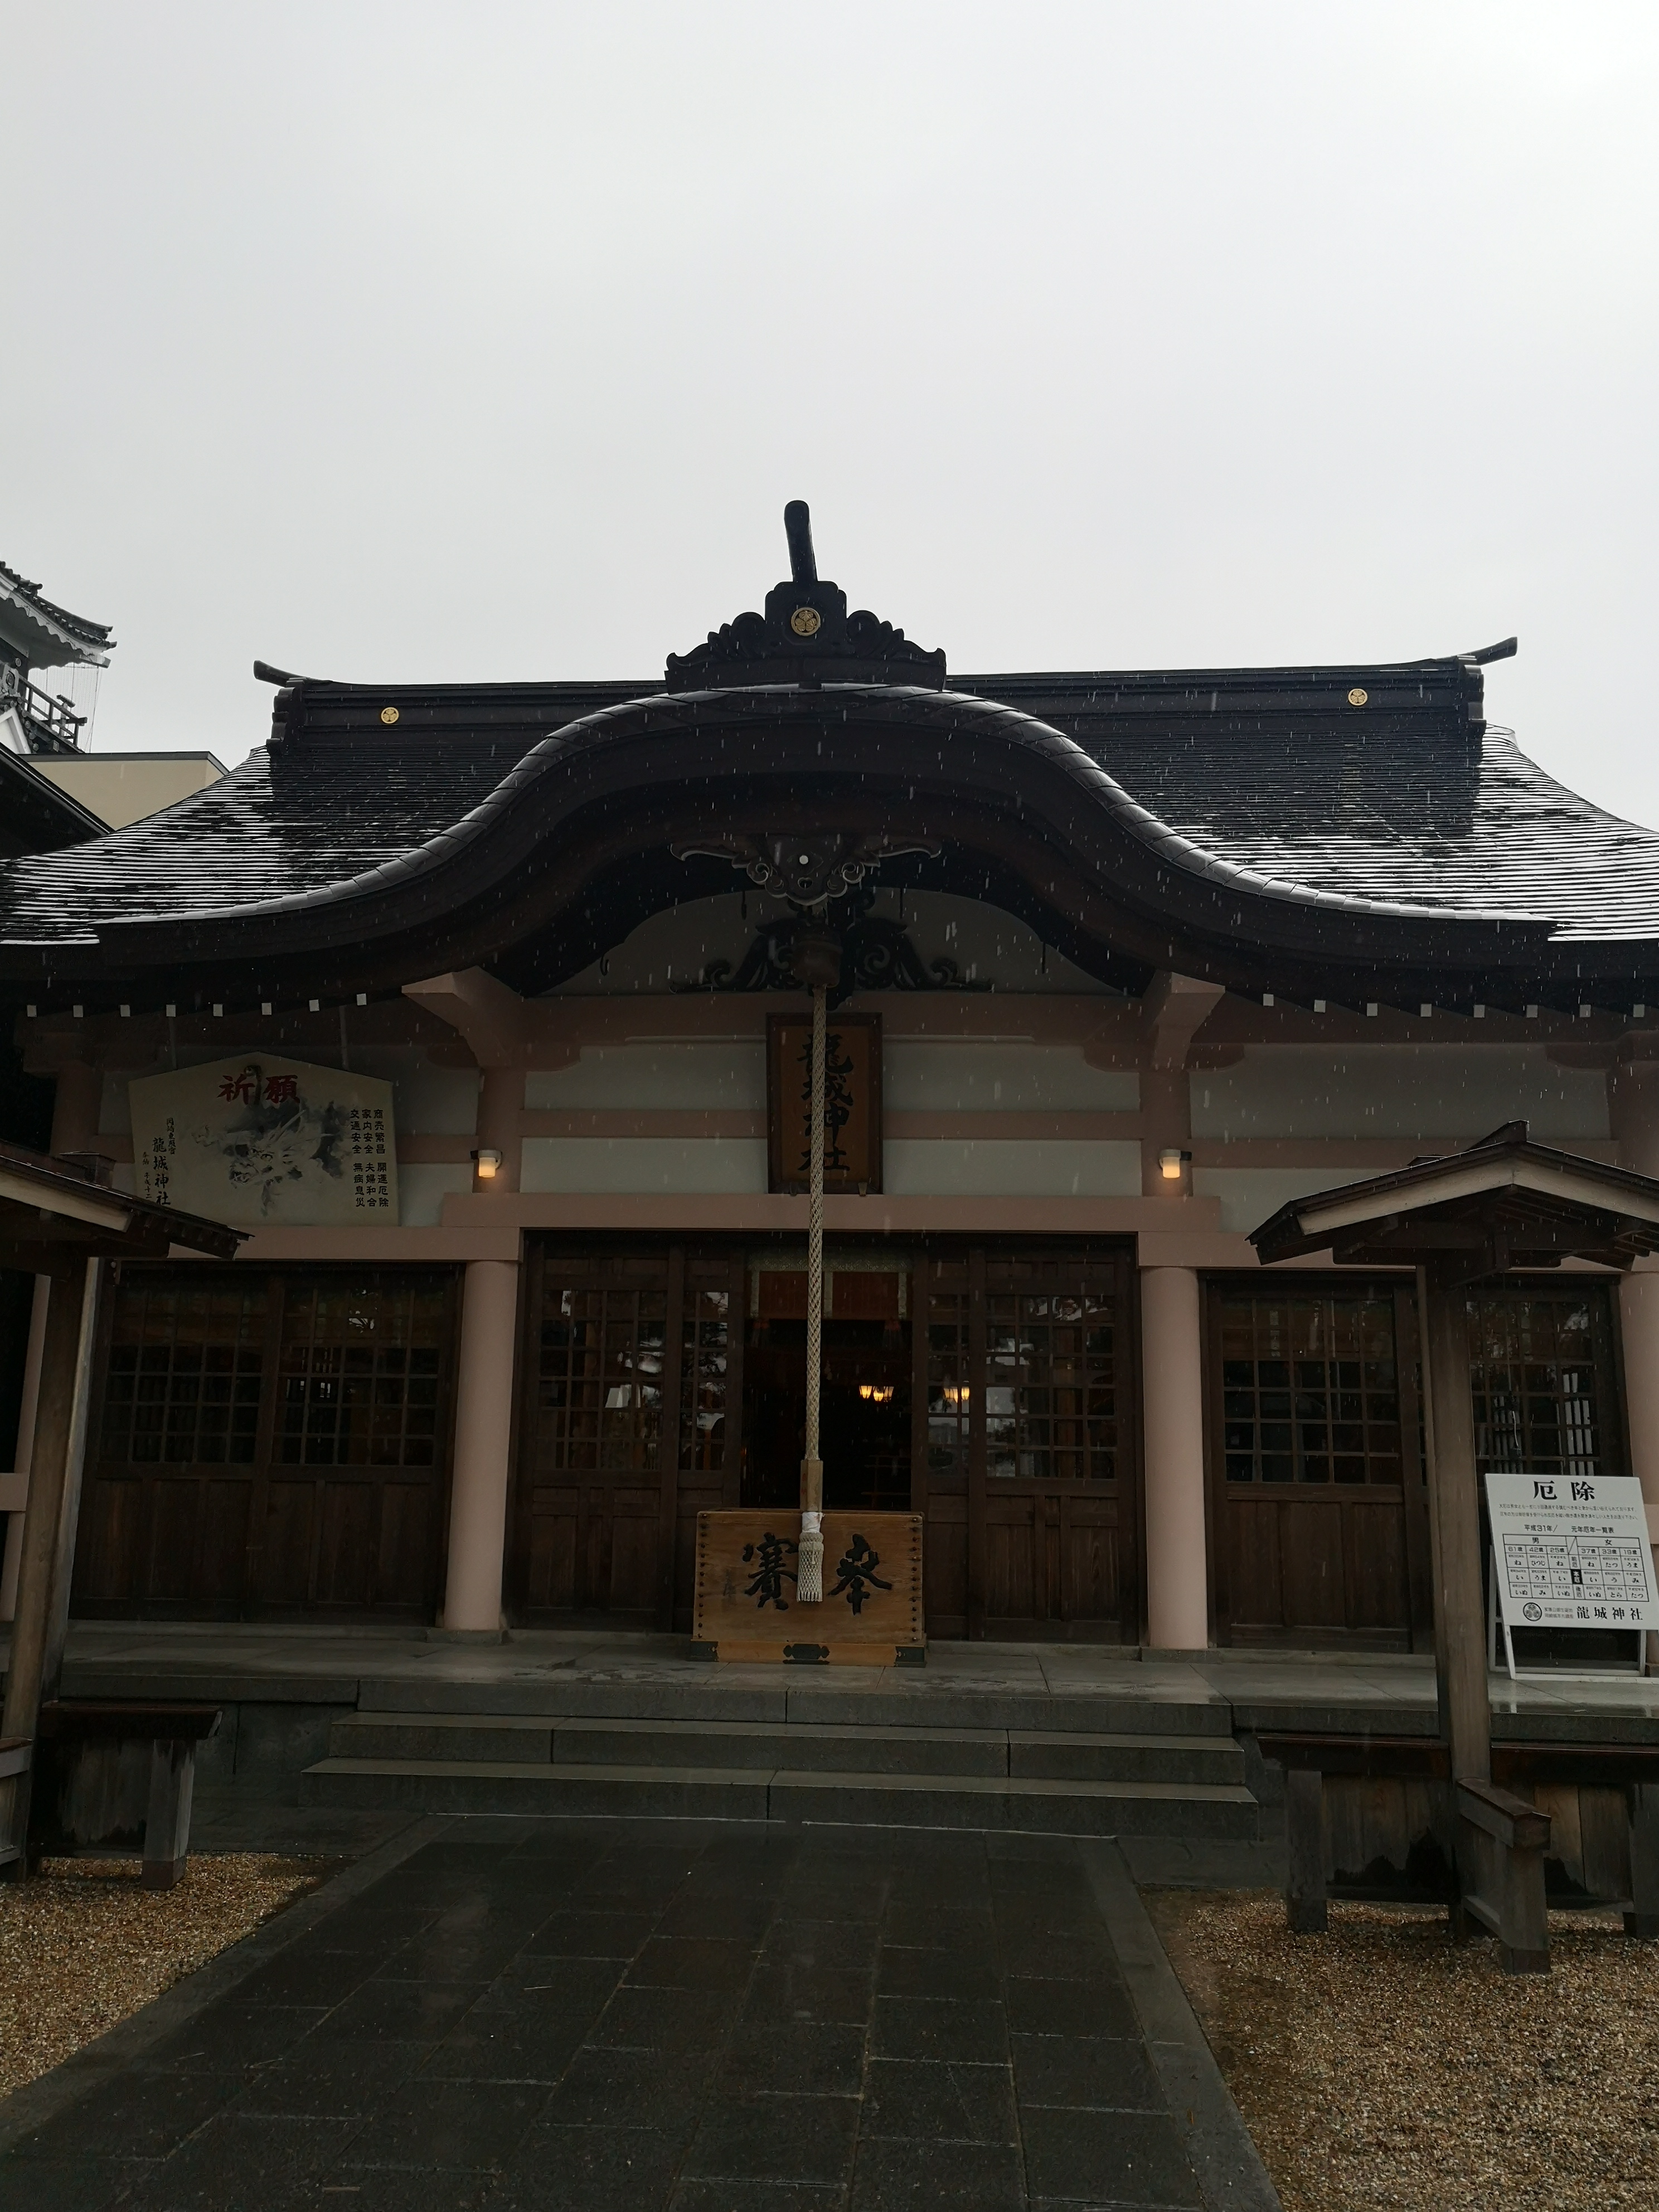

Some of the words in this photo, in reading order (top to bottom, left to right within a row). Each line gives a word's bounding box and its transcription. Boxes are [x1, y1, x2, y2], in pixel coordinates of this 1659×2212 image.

[216, 1073, 300, 1105] 祈願
[350, 1109, 362, 1154] 交通安全
[362, 1109, 374, 1154] 家内安全
[373, 1109, 385, 1154] 商売繁昌
[152, 1137, 171, 1205] 龍城神社
[353, 1162, 365, 1207] 無病息災
[365, 1162, 377, 1207] 夫婦和合
[377, 1162, 389, 1207] 開運厄除
[1534, 1481, 1595, 1501] 厄除
[1576, 1606, 1643, 1621] 龍城神社
